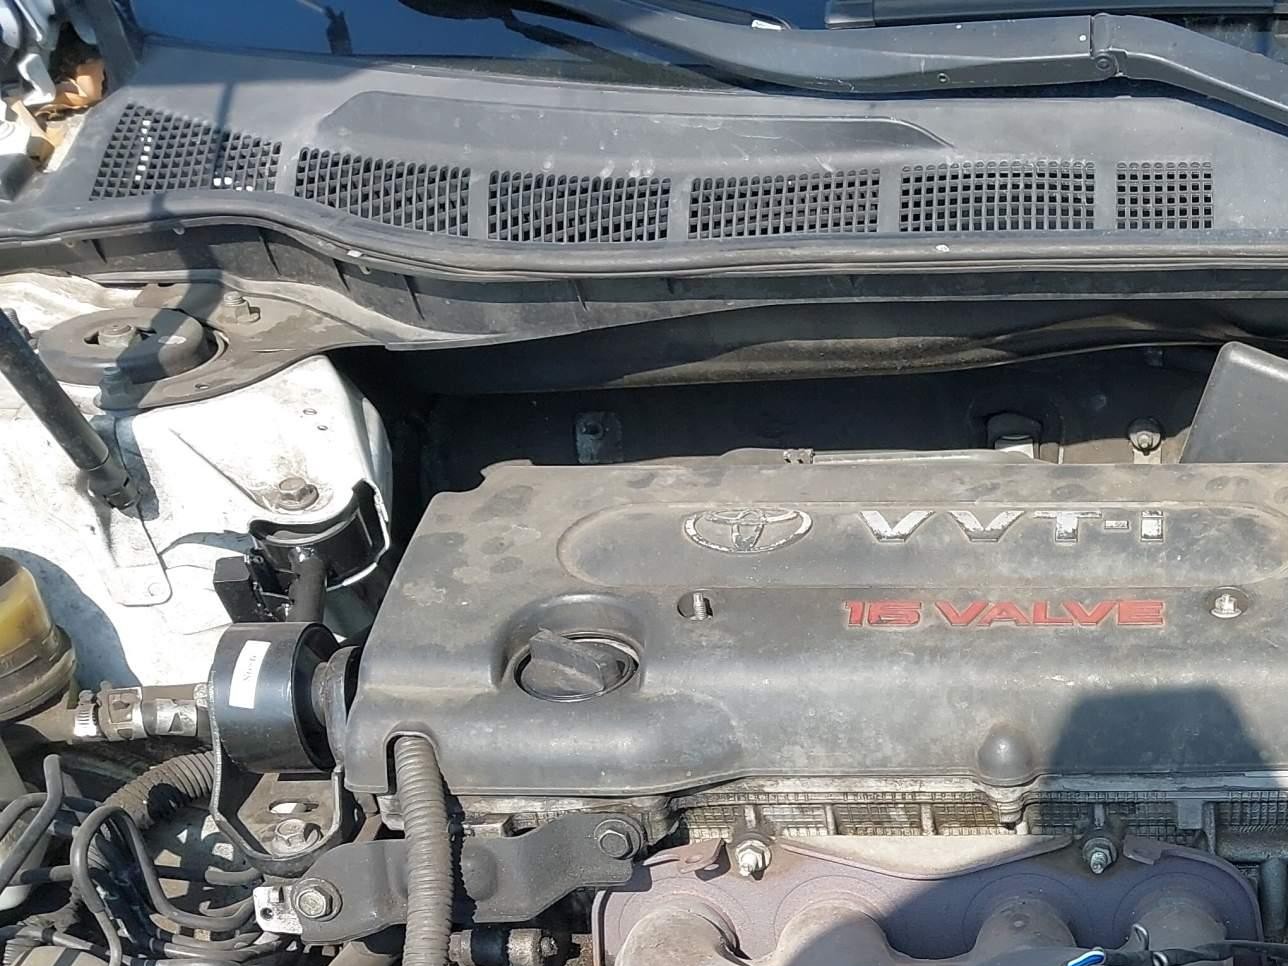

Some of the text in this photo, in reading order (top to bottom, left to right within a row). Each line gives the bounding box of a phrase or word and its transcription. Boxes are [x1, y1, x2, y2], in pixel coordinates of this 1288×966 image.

[860, 510, 1164, 542] VVT-i
[847, 600, 1164, 627] 16 VALVE
